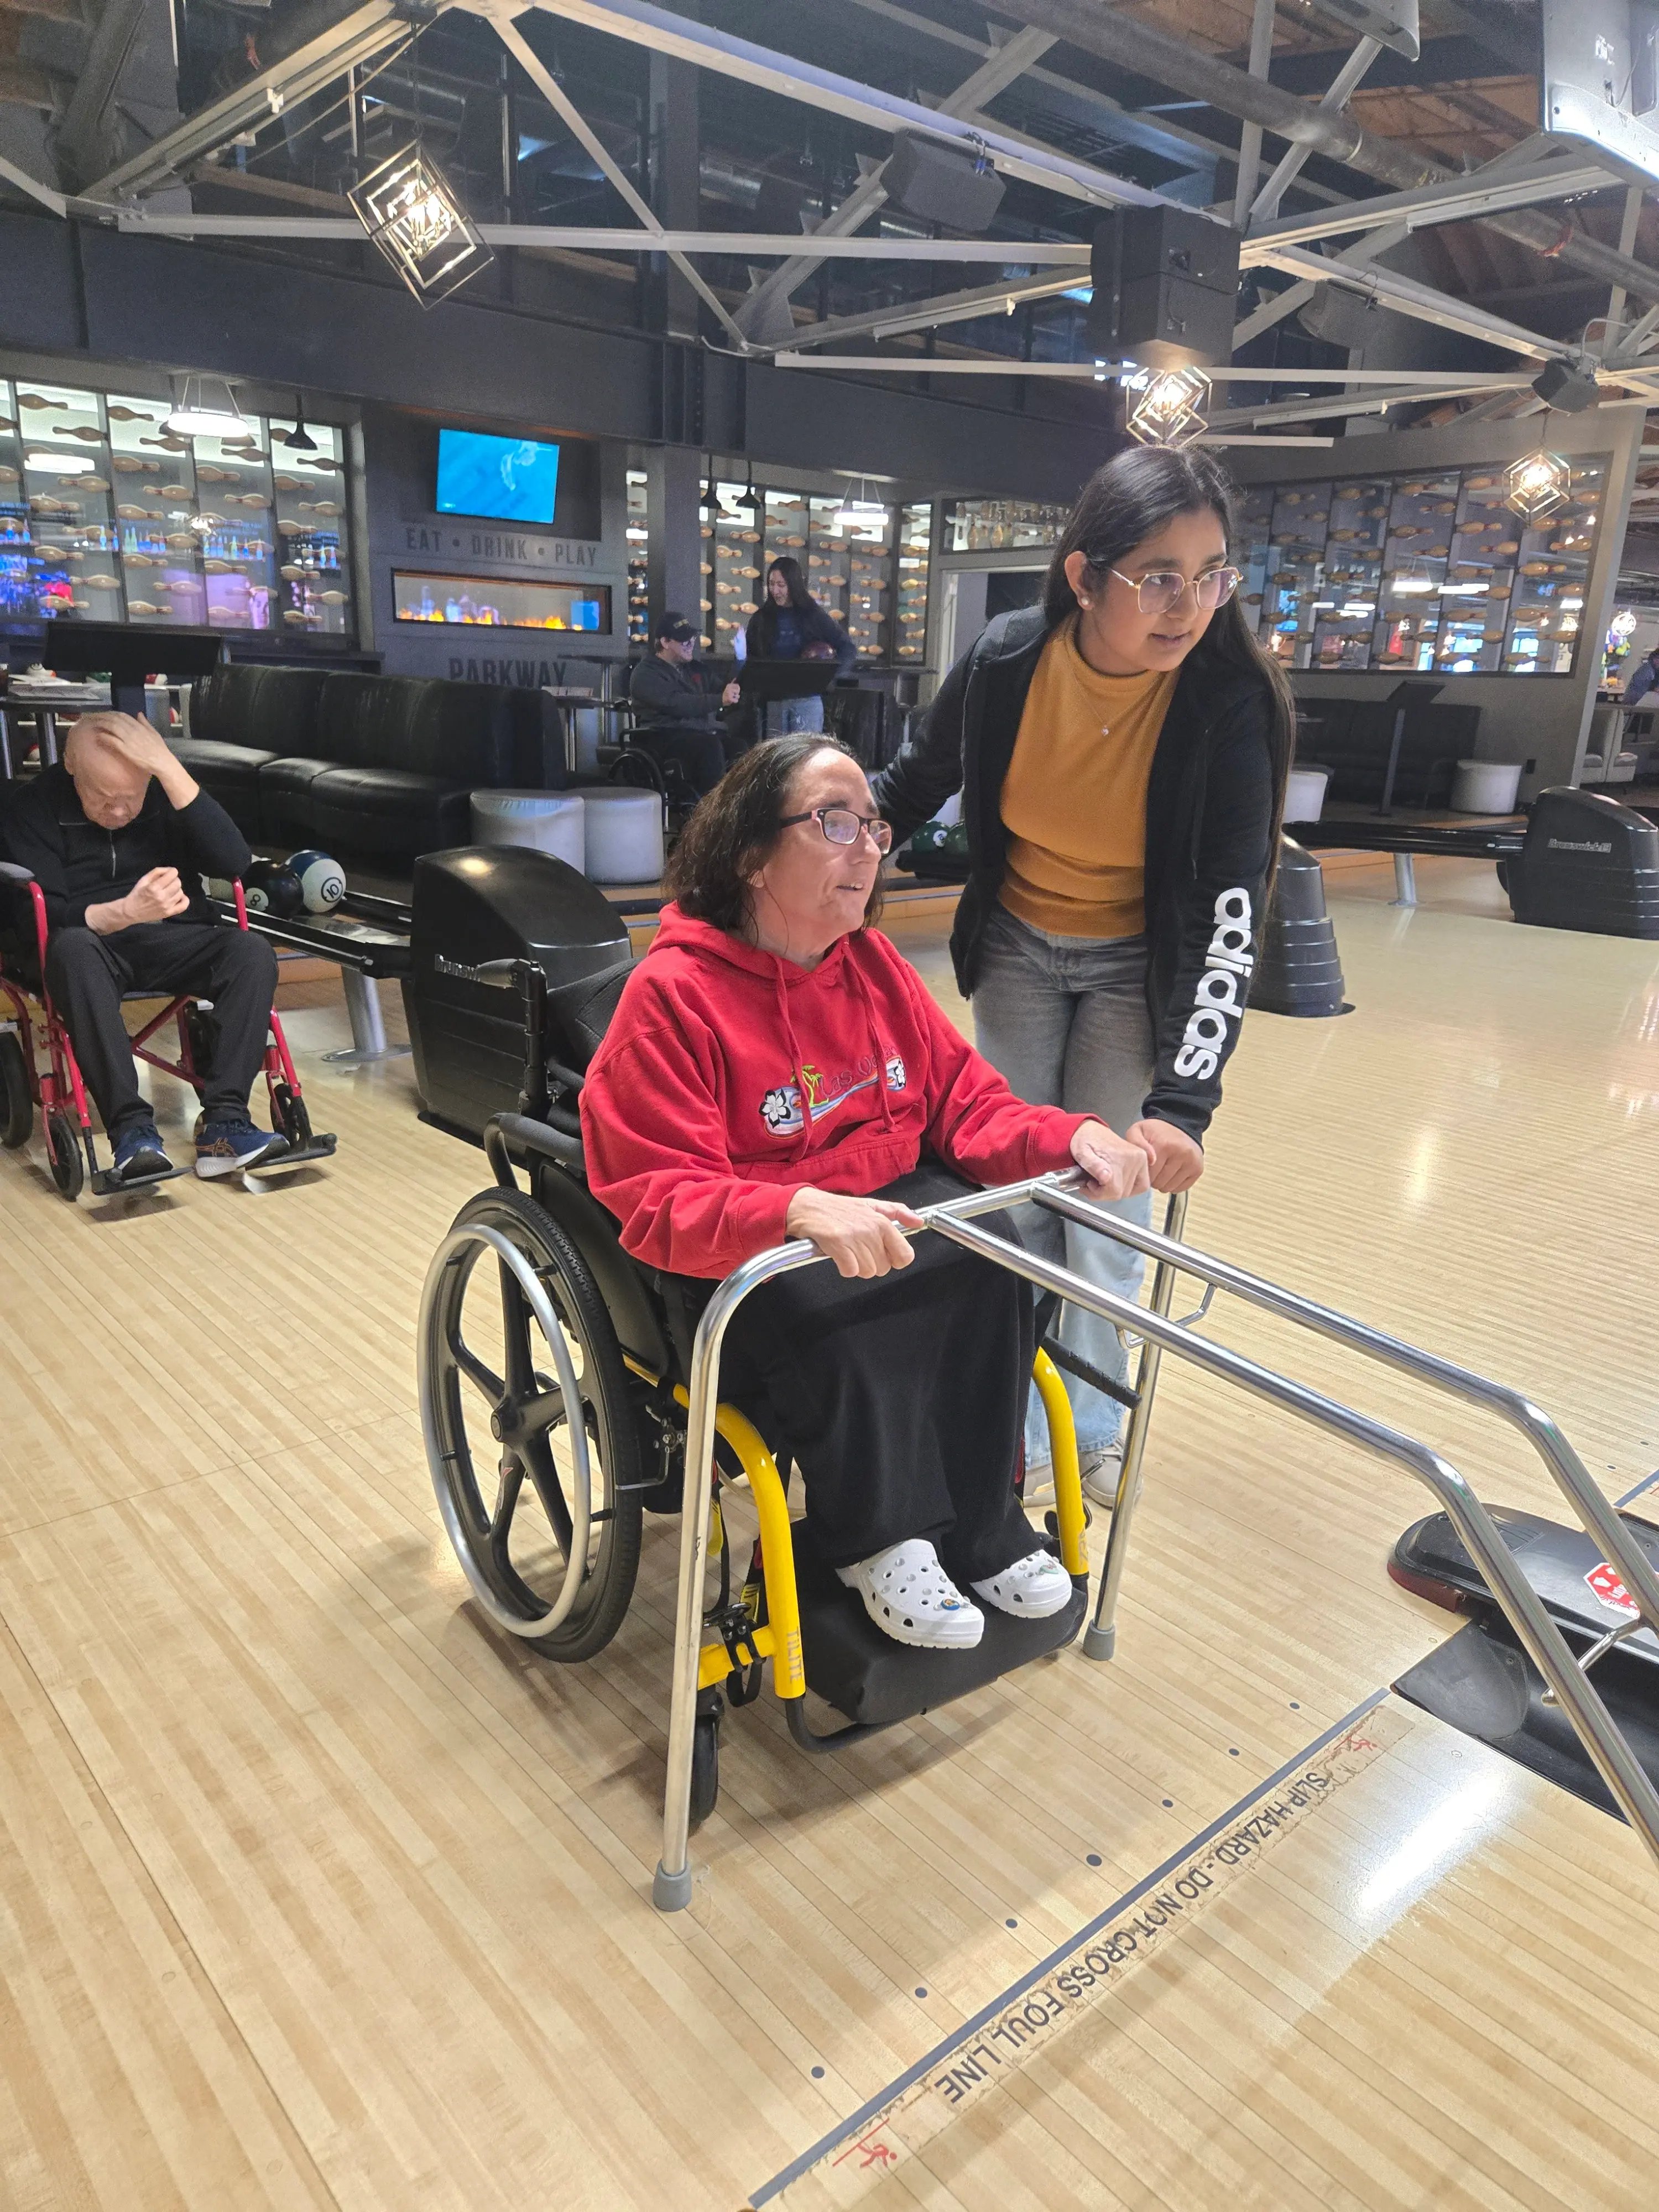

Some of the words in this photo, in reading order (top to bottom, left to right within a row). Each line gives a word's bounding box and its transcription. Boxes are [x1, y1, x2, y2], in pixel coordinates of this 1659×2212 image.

[406, 528, 441, 551] EAT
[471, 535, 528, 560] DRINK
[555, 543, 597, 567] PLAY
[449, 658, 567, 687] PARKWAY
[250, 893, 261, 906] 8
[326, 884, 340, 899] 10
[1173, 887, 1254, 1080] adidas
[1287, 1771, 1328, 1808] SLIP
[1215, 1800, 1295, 1866] HAZARD
[1175, 1867, 1214, 1900] DO
[1132, 1896, 1185, 1939] NOT
[1056, 1930, 1138, 1999] CROSS
[991, 1991, 1065, 2048] FOUL
[934, 2043, 1002, 2104] LINE
